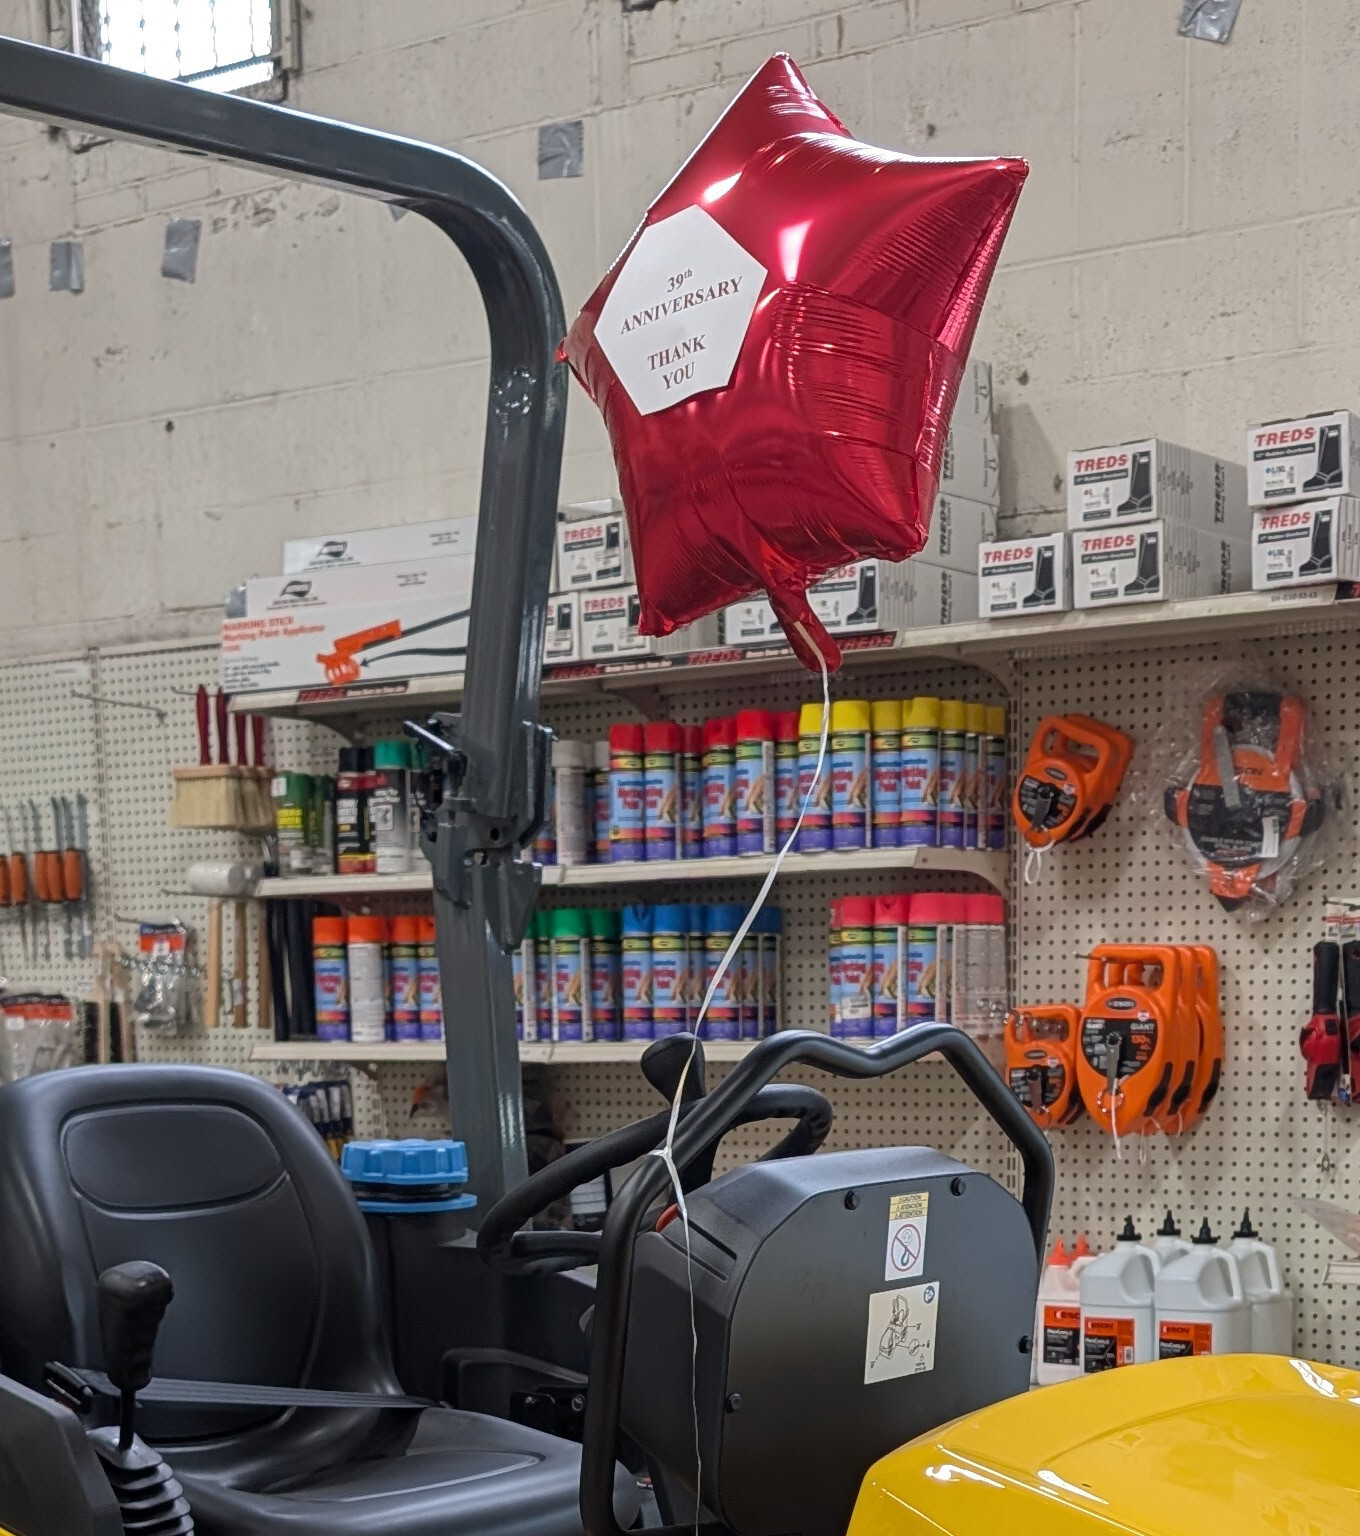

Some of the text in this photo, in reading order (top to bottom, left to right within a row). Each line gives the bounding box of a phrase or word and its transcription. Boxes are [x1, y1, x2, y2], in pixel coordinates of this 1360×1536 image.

[666, 268, 693, 293] 39th
[620, 276, 743, 335] ANNIVERSARY
[647, 334, 707, 371] THANK
[662, 362, 695, 391] YOU
[1254, 427, 1317, 447] TREDS
[1074, 454, 1130, 473] TREDS
[1259, 512, 1313, 530] TREDS
[1081, 534, 1138, 551] TREDS
[983, 547, 1035, 564] TREDS
